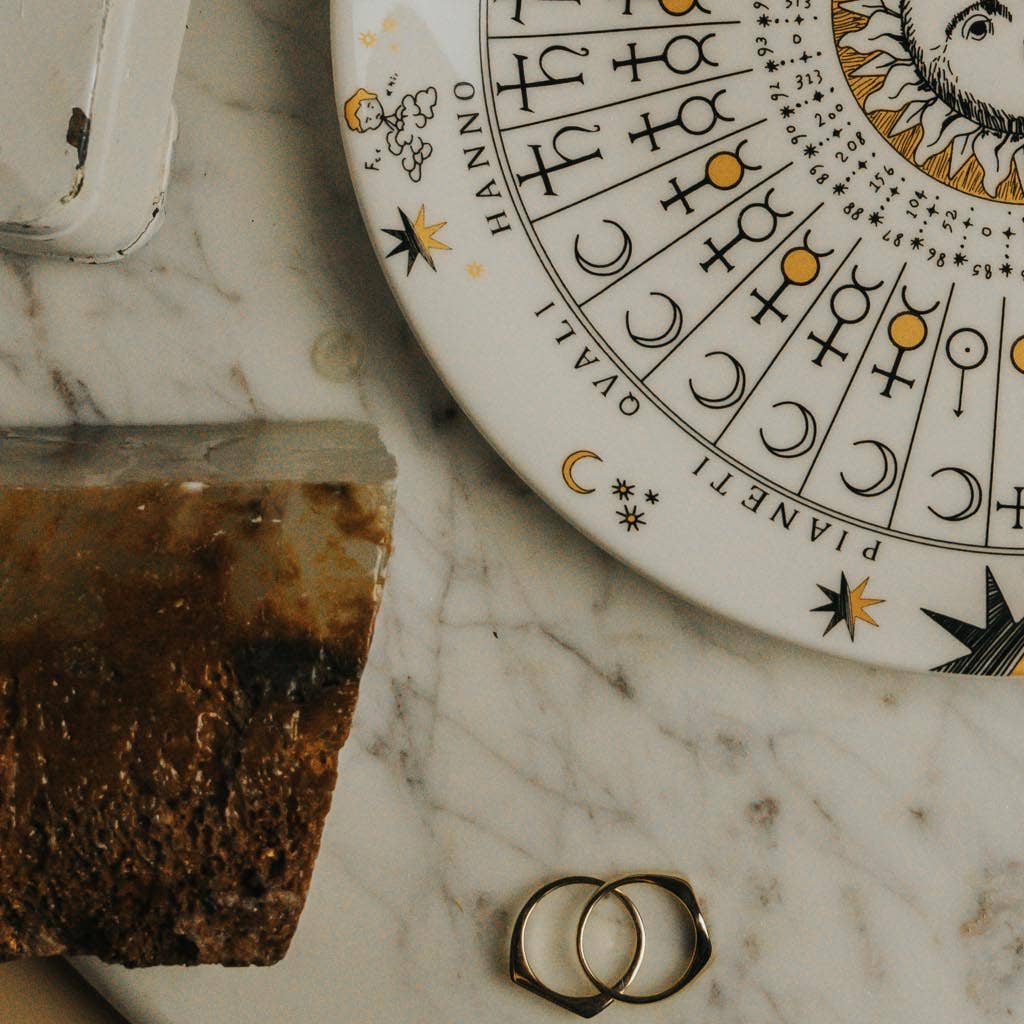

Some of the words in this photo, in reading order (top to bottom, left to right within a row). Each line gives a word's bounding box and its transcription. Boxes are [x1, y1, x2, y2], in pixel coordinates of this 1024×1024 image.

[755, 37, 774, 56] 93
[786, 125, 807, 145] 90
[453, 82, 512, 236] HANNO
[809, 165, 829, 184] 89
[843, 202, 864, 221] 88
[882, 230, 904, 247] 87
[927, 248, 946, 267] 86
[972, 264, 992, 280] 85
[692, 456, 882, 561] PIANETI
